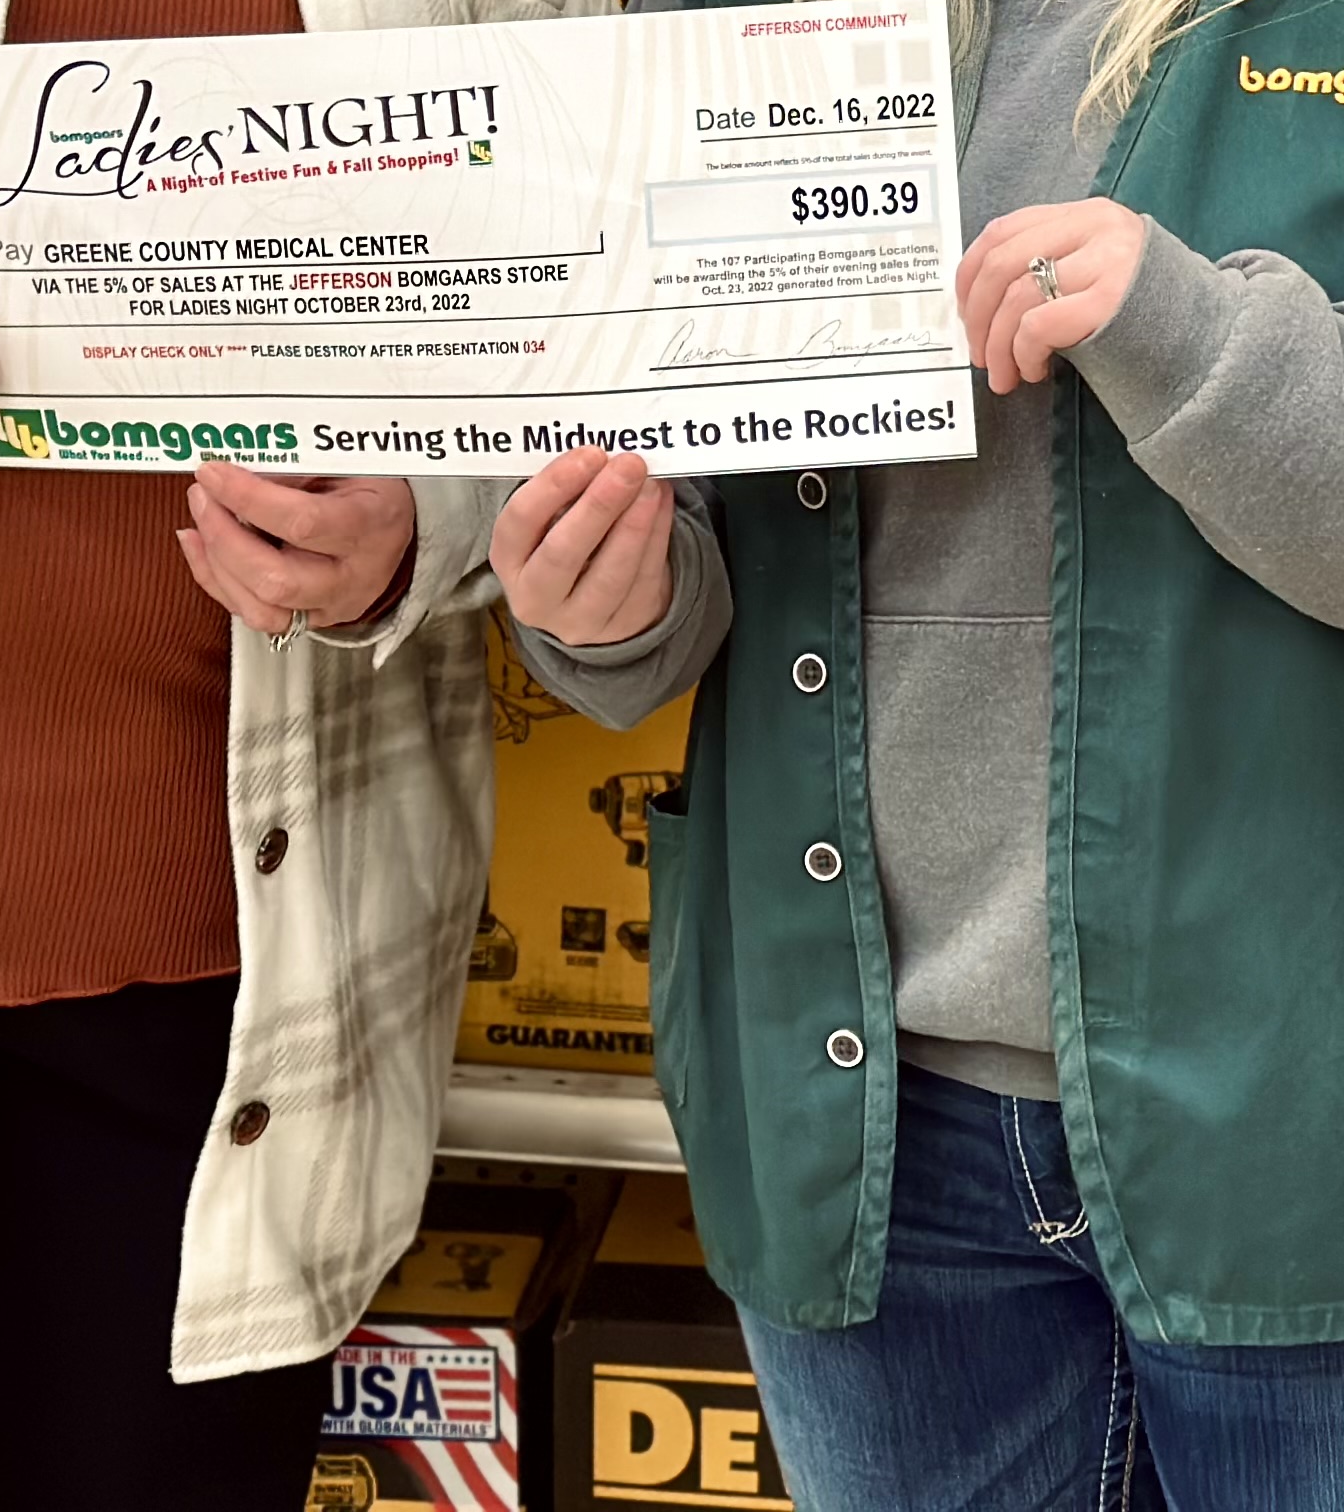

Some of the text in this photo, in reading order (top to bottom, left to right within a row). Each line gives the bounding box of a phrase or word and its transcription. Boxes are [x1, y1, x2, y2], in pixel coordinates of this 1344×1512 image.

[741, 13, 907, 38] JEFFERSON COMMUNITY
[237, 84, 500, 156] NIGHT!
[695, 92, 936, 131] Date Dec. 16, 2022
[49, 126, 124, 146] bomgaars
[146, 148, 460, 195] A Night of Festive Fun & Fall Shopping!
[791, 180, 919, 226] $390.39
[44, 242, 133, 265] GREENE
[138, 239, 229, 263] COUNTY
[235, 237, 333, 261] MEDICAL
[338, 234, 430, 257] CENTER
[696, 258, 718, 269] The
[743, 251, 816, 266] Participating
[818, 248, 877, 262] Bomgaars
[31, 264, 568, 295] VIA THE 5% OF SALES AT THE JEFFERSON BOMGAARS STORE
[653, 256, 940, 286] will be awarding the 5% of their evening sales from
[701, 284, 726, 297] Oct.
[747, 281, 774, 293] 2022
[777, 277, 834, 293] generated
[836, 275, 863, 287] from
[865, 272, 904, 285] Ladies
[129, 292, 471, 317] FOR LADIES NIGHT OCTOBER 23rd, 2022
[82, 340, 546, 360] DISPLAY CHECK ONLY PLEASE DESTROY AFTER PRESENTATION 034
[44, 398, 956, 462] bomgaars Serving the Midwest to the Rockies!
[486, 1024, 654, 1055] GUARANTE
[367, 1349, 417, 1365] IN THE
[331, 1365, 442, 1420] USA
[322, 1419, 488, 1437] WITH GLOBAL MATERIALS
